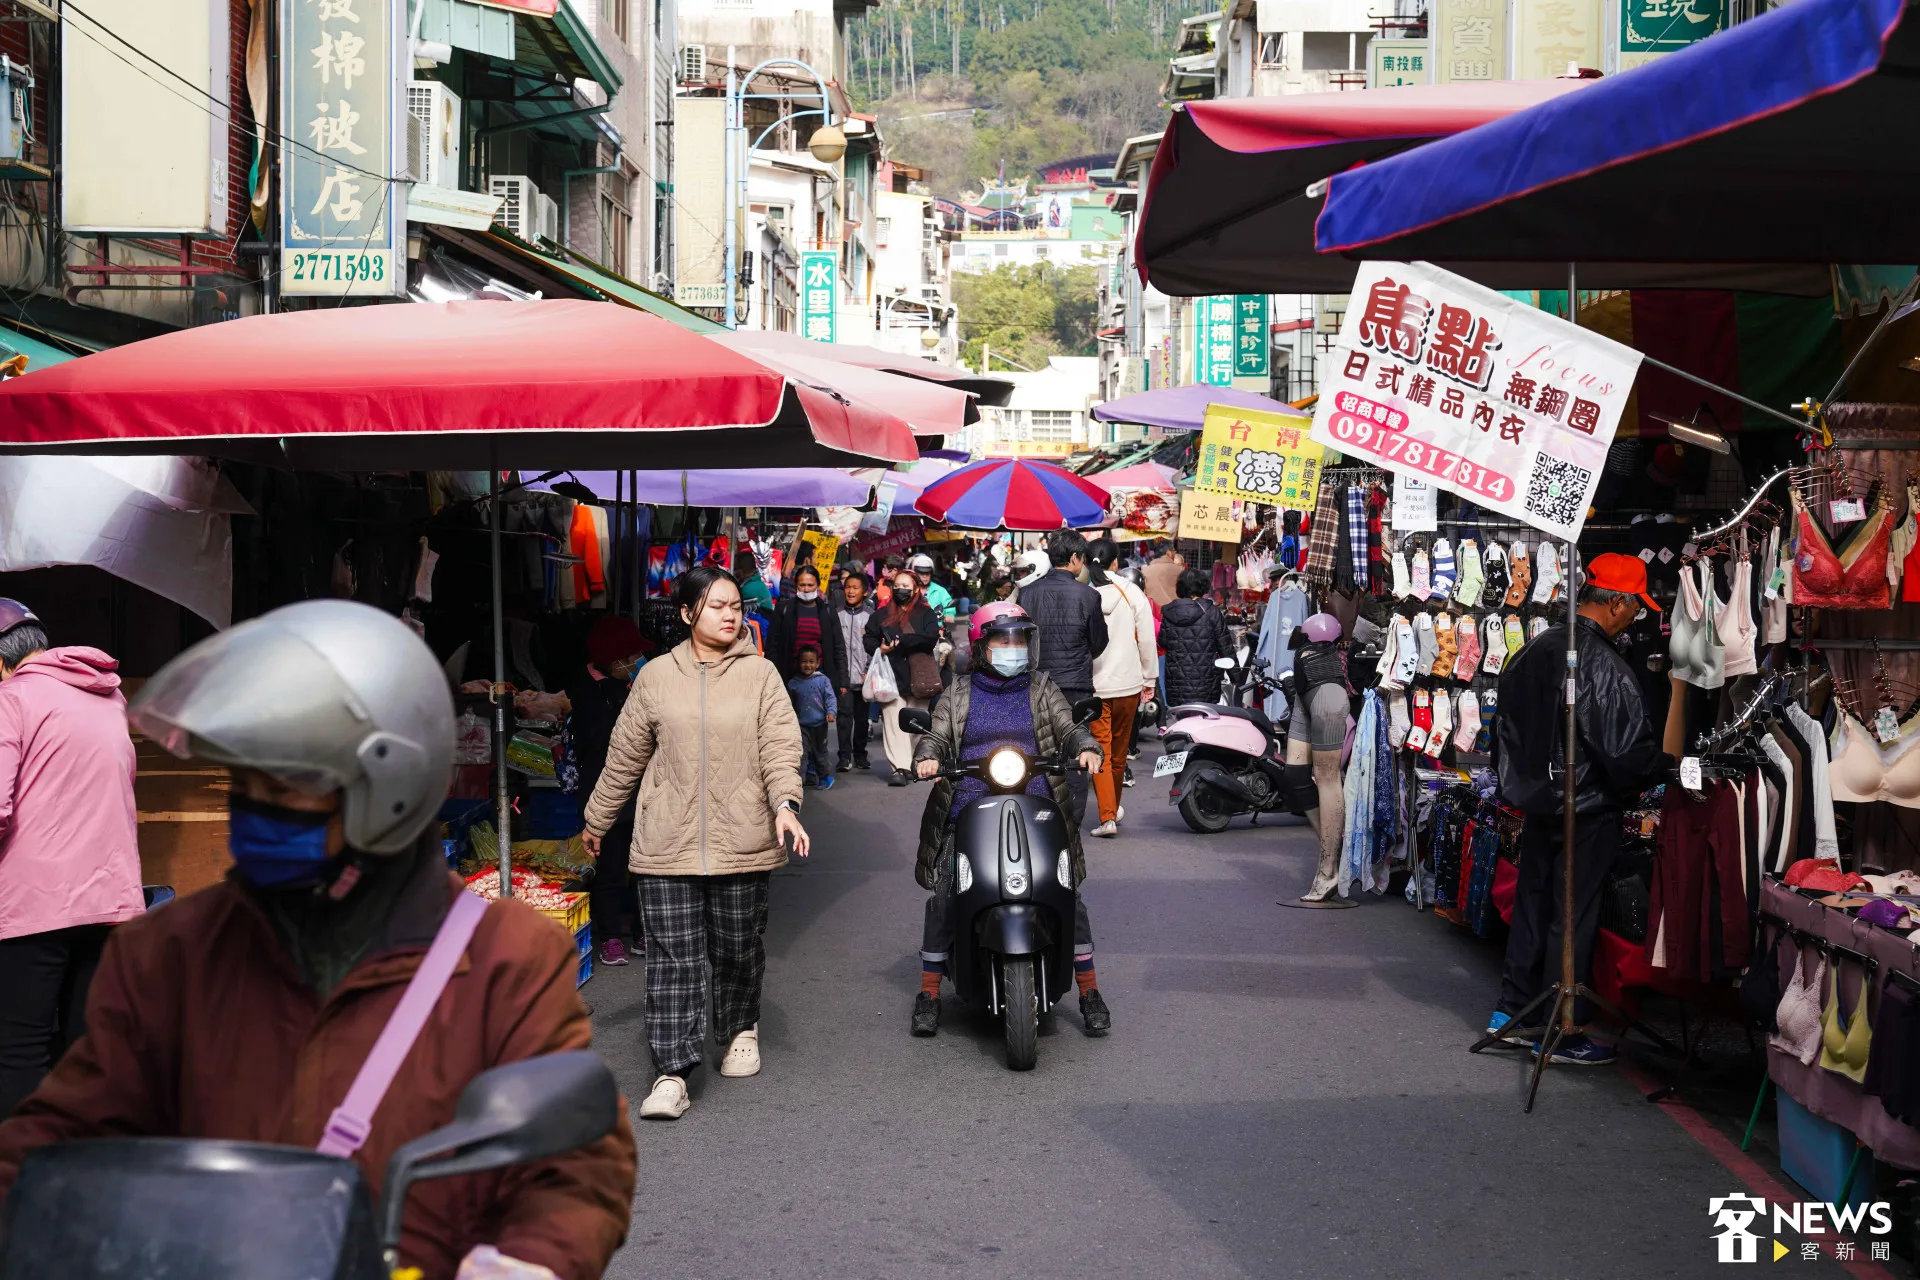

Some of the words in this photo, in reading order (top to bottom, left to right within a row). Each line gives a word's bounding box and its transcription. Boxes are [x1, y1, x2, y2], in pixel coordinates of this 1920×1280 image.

[1382, 55, 1424, 72] 南投縣
[293, 253, 384, 282] 2771593
[680, 287, 727, 300] 2773637
[1210, 295, 1232, 383] 勝棉被行
[1240, 294, 1263, 368] 中醫診所
[1359, 276, 1503, 393] 焦點
[1505, 344, 1614, 397] focus
[1343, 350, 1527, 446] 日式精品內衣
[1503, 371, 1602, 436] 無鋼圈
[1229, 420, 1301, 450] 台灣
[1336, 415, 1506, 502] 0917817814
[1215, 445, 1233, 489] 健康襪
[1298, 457, 1317, 501] 保證不臭
[1193, 504, 1230, 522] 芯晨
